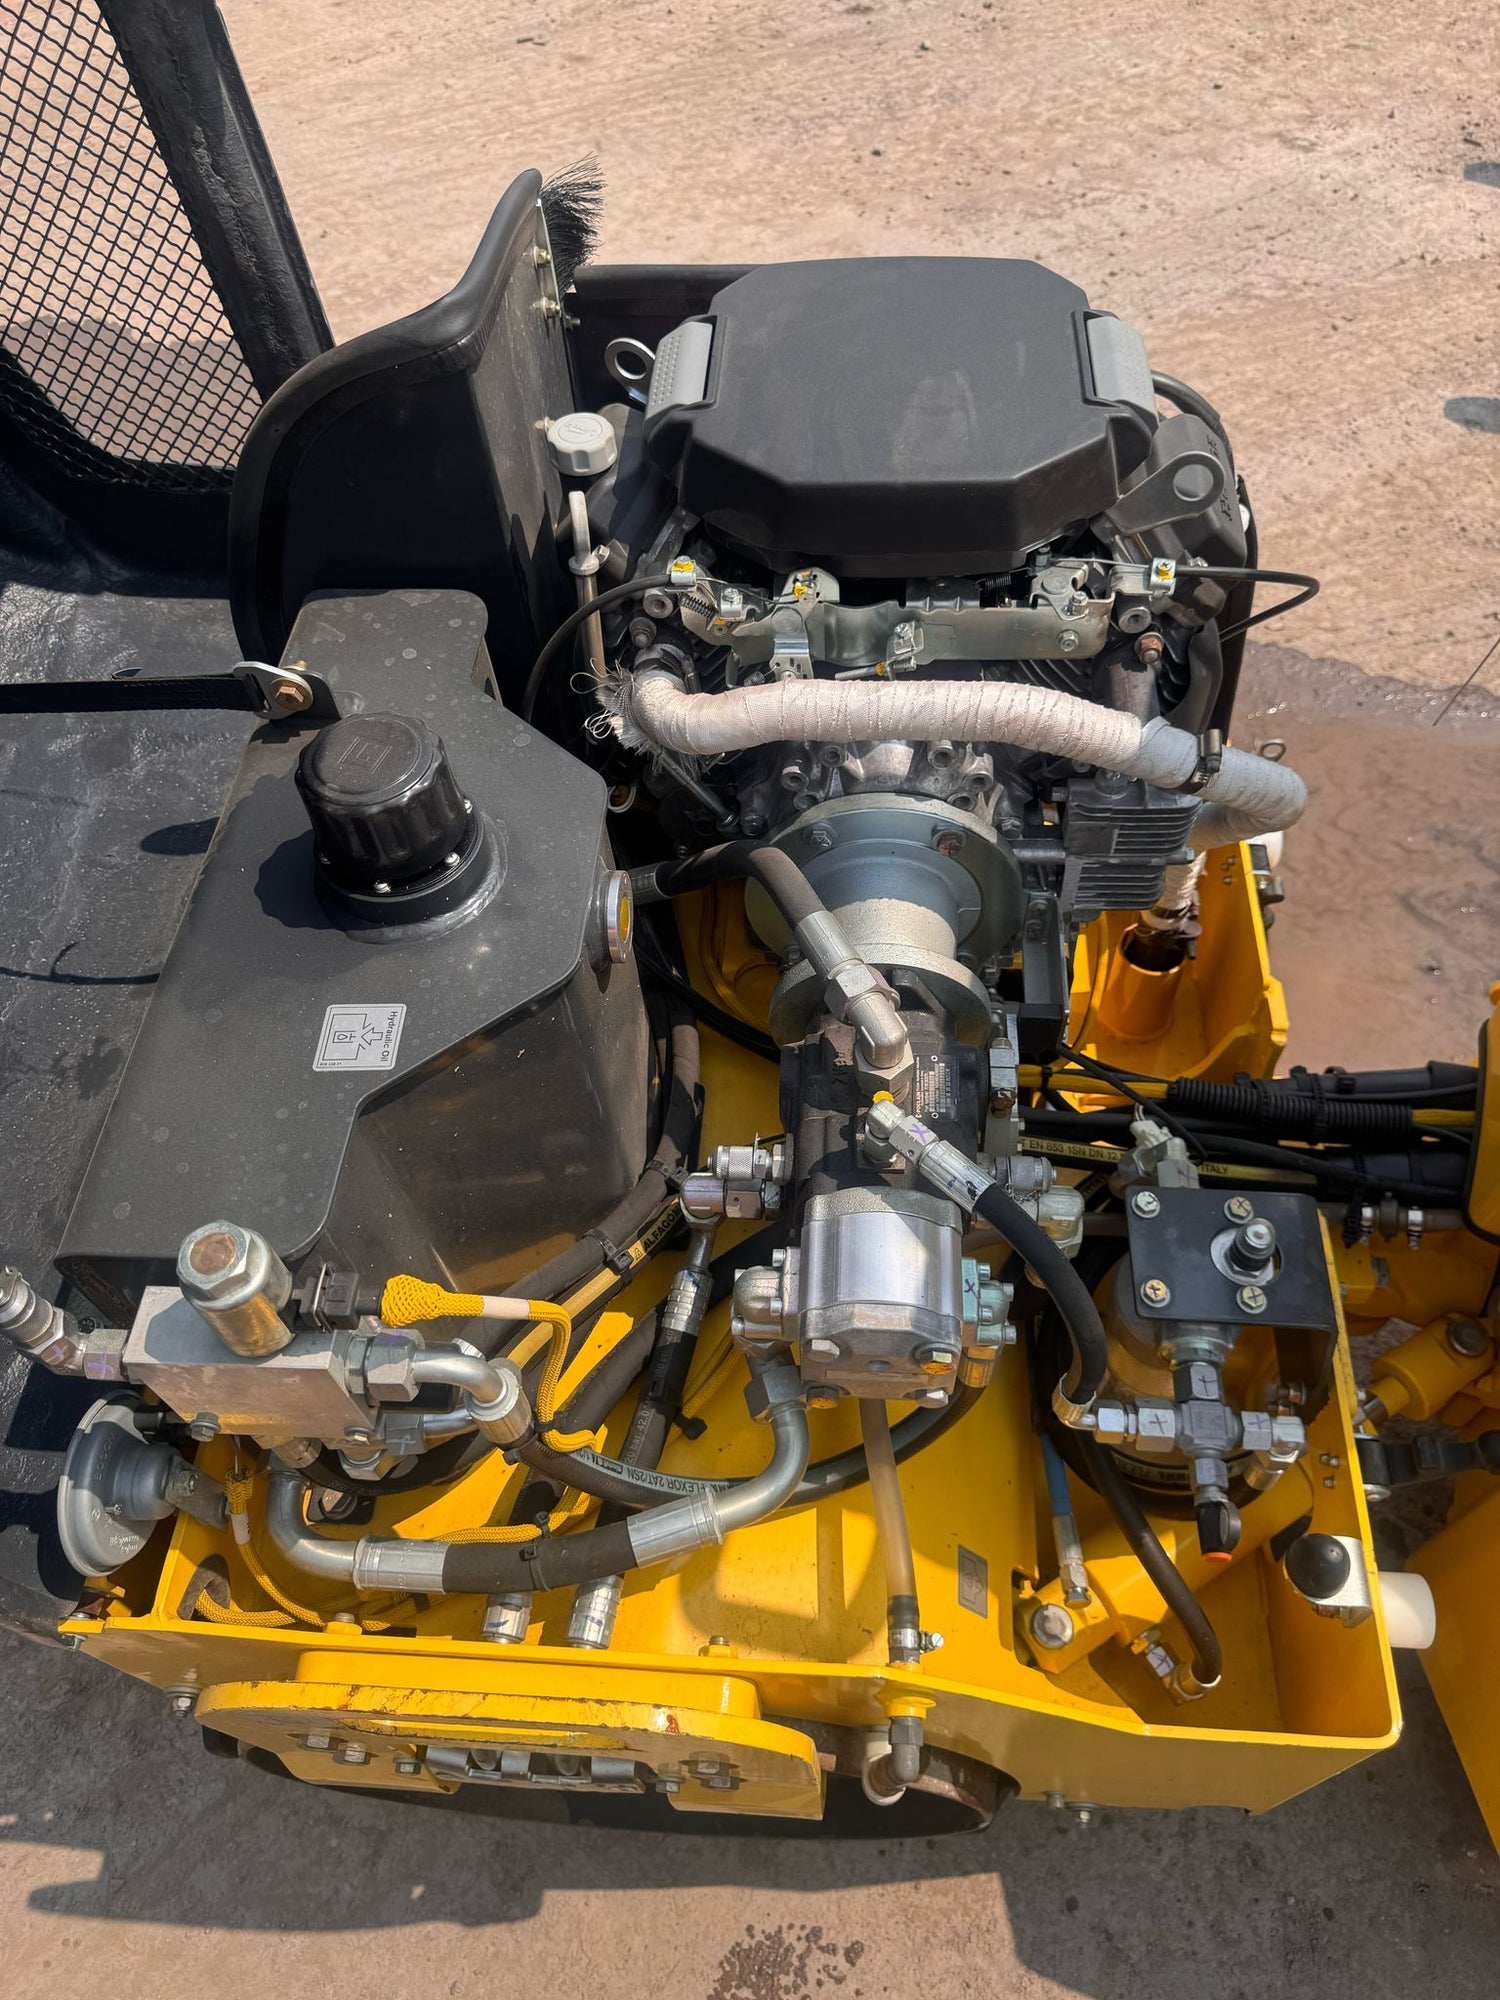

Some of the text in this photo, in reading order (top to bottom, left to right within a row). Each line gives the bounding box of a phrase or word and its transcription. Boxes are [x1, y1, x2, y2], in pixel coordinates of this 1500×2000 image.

[380, 1011, 398, 1062] Hydraulic Oil
[1029, 1142, 1044, 1150] EN
[1088, 1149, 1104, 1159] DN
[1106, 1151, 1118, 1160] 12
